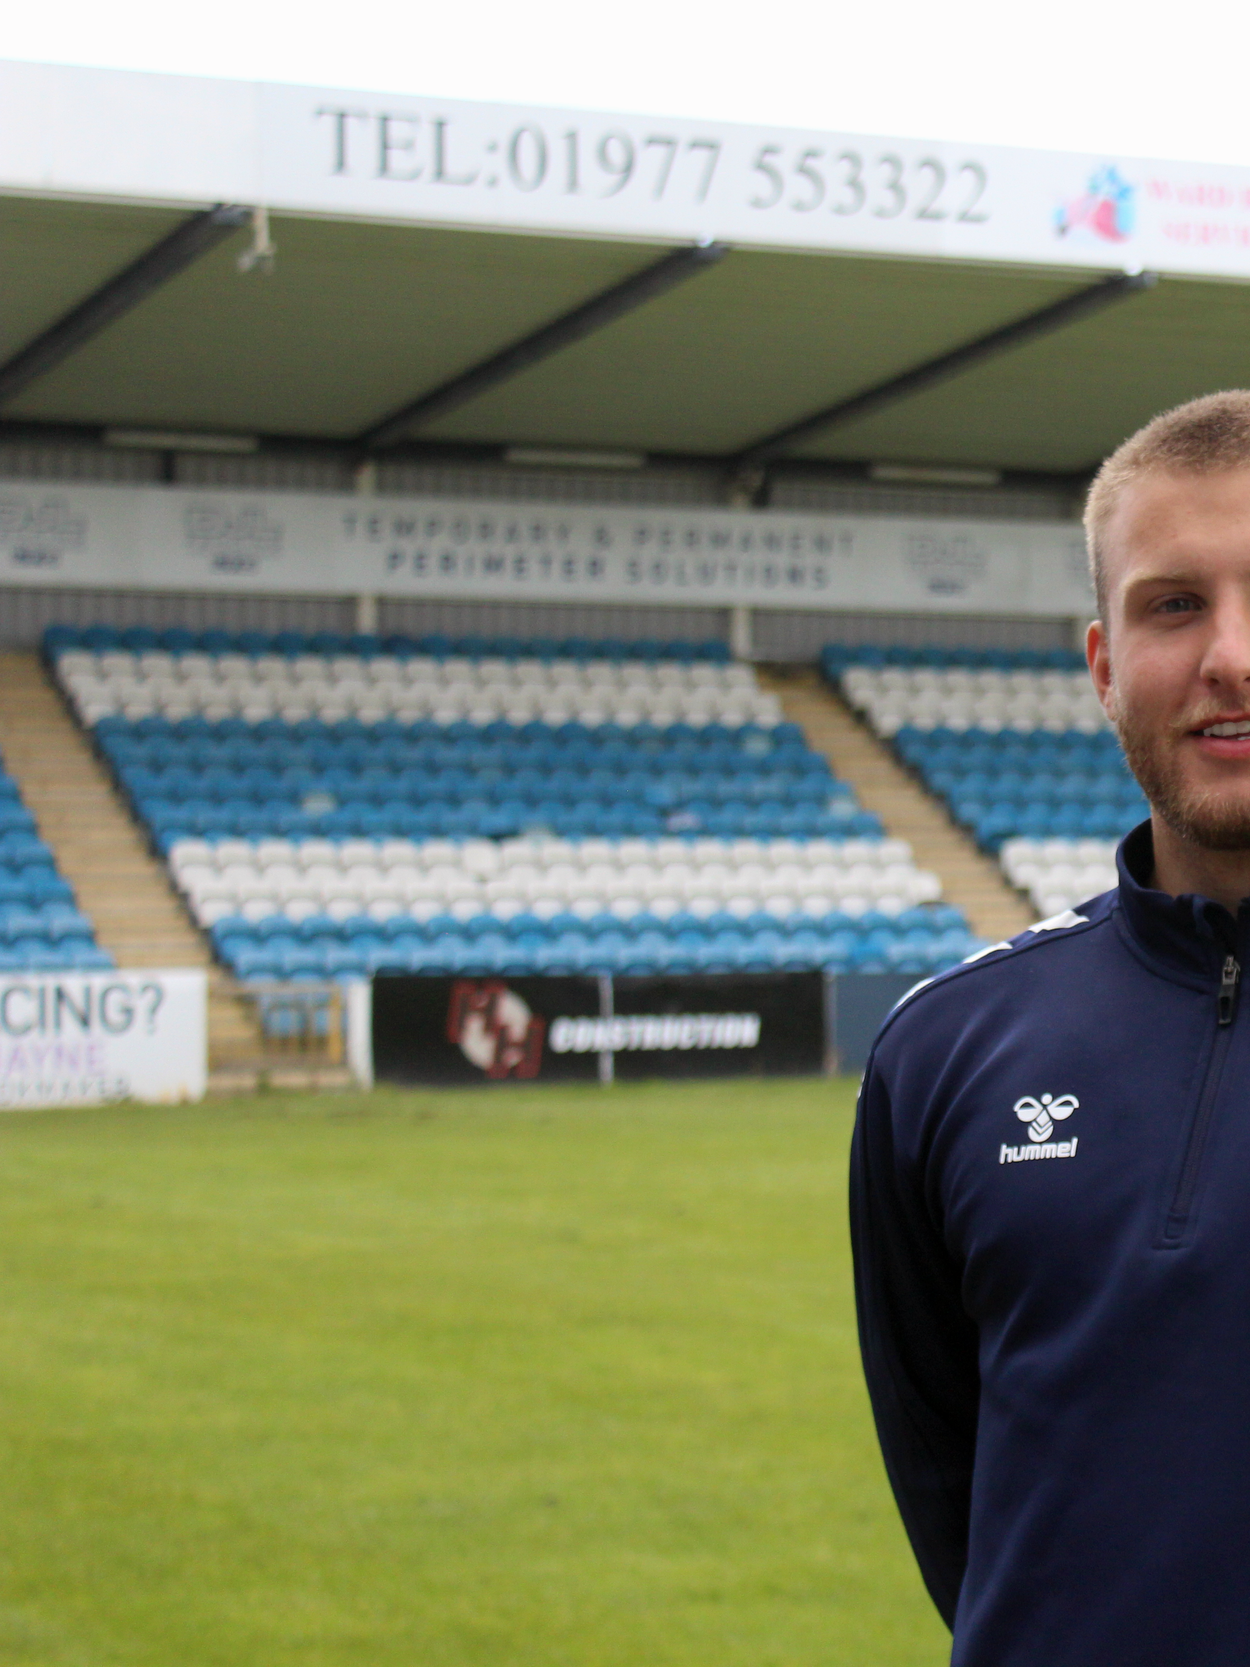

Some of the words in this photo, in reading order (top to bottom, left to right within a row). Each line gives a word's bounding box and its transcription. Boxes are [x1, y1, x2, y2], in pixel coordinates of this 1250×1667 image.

[747, 143, 992, 224] 553322
[343, 511, 570, 546] TEMPORARY
[631, 524, 854, 557] PERMANENT
[386, 548, 605, 582] PERIMETER
[625, 556, 830, 590] SOLUTIONS
[549, 1013, 760, 1053] CONSTRUCTION
[999, 1136, 1078, 1164] hummel
